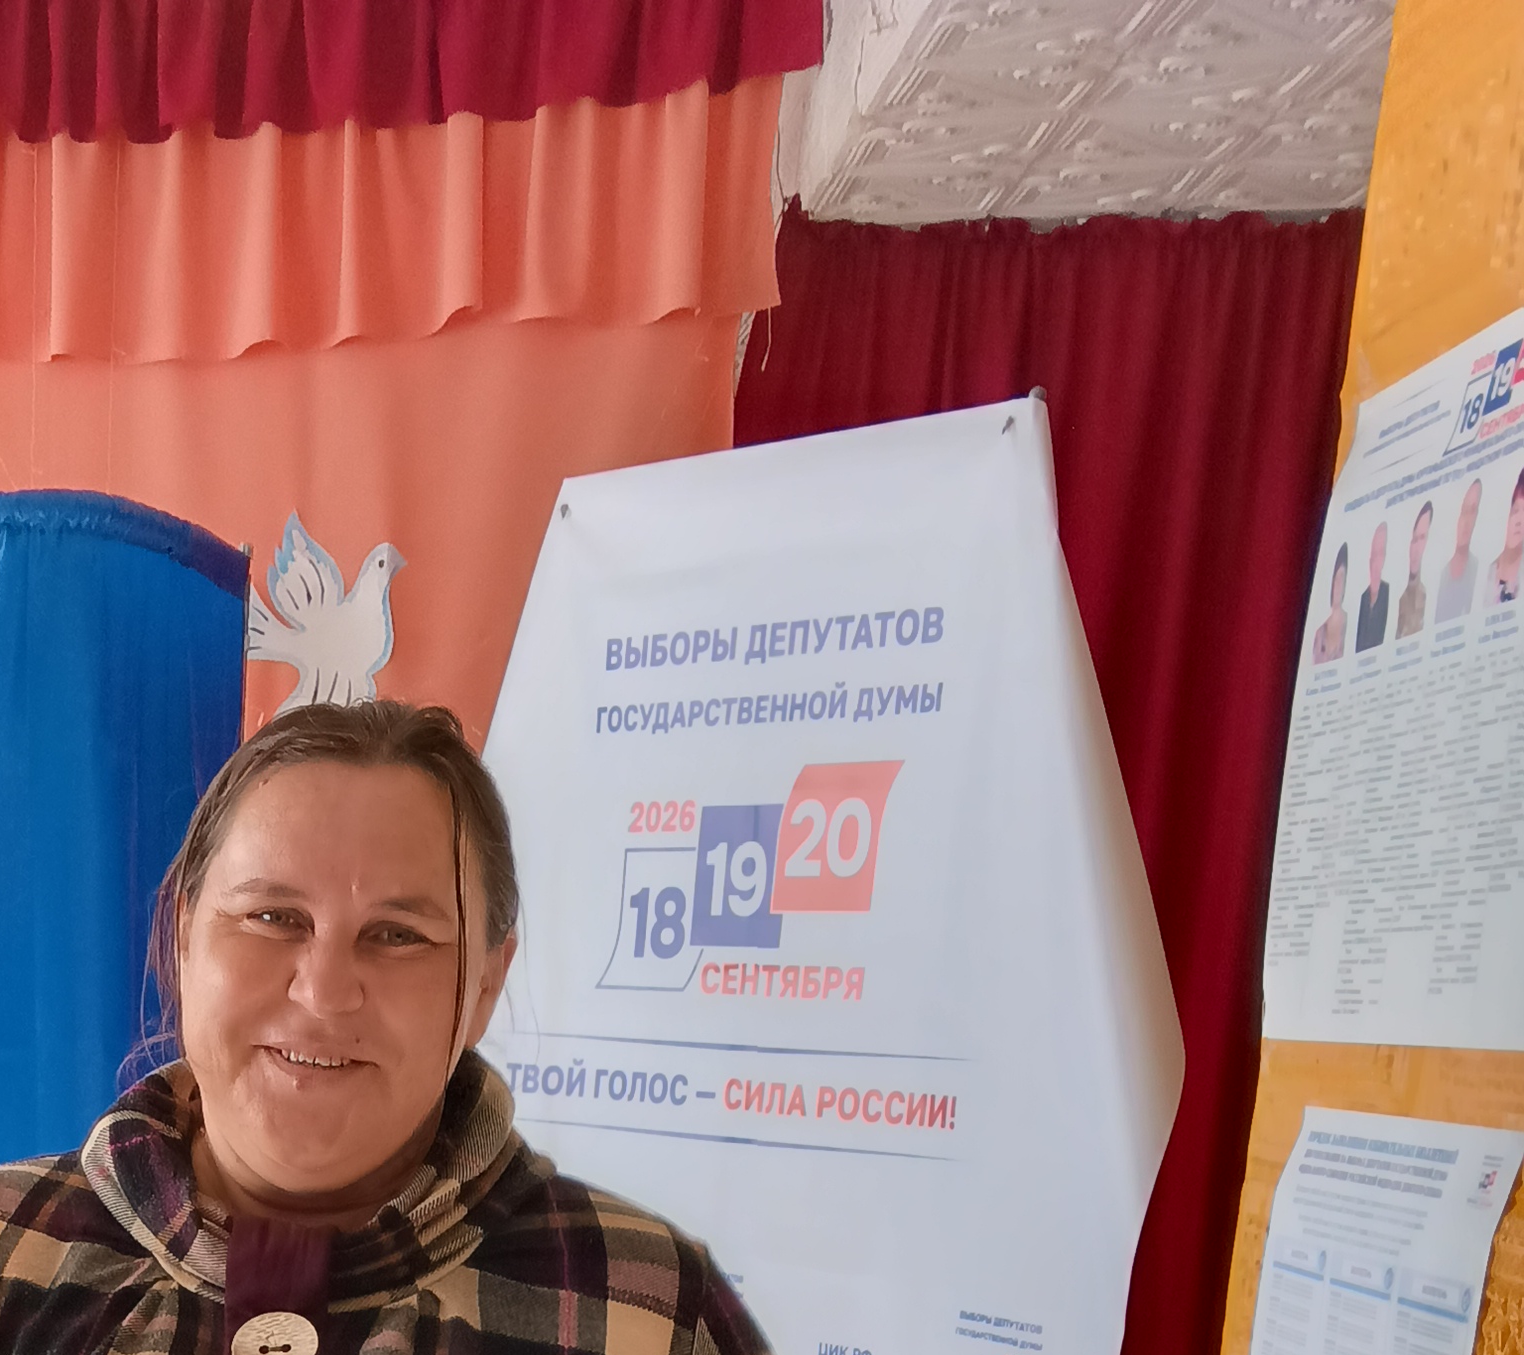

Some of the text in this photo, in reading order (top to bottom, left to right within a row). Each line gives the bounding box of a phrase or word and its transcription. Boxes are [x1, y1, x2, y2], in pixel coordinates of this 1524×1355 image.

[1460, 393, 1484, 434] 18
[1491, 357, 1516, 401] 19
[605, 606, 945, 671] ВЫБОРЫ ДЕПУТАТОВ
[595, 681, 944, 735] ГОСУДАРСТВЕННОЙ ДУМЫ
[628, 799, 697, 833] 2026
[629, 796, 872, 960] 18 19 20
[699, 961, 866, 1001] СЕНТЯБРЯ
[506, 1058, 586, 1097] ТВОЙ
[593, 1069, 689, 1106] ГОЛОС
[723, 1078, 806, 1118] СИЛА
[815, 1086, 958, 1131] РОССИИ!
[993, 1317, 1042, 1334] ДЕПУТАТОВ
